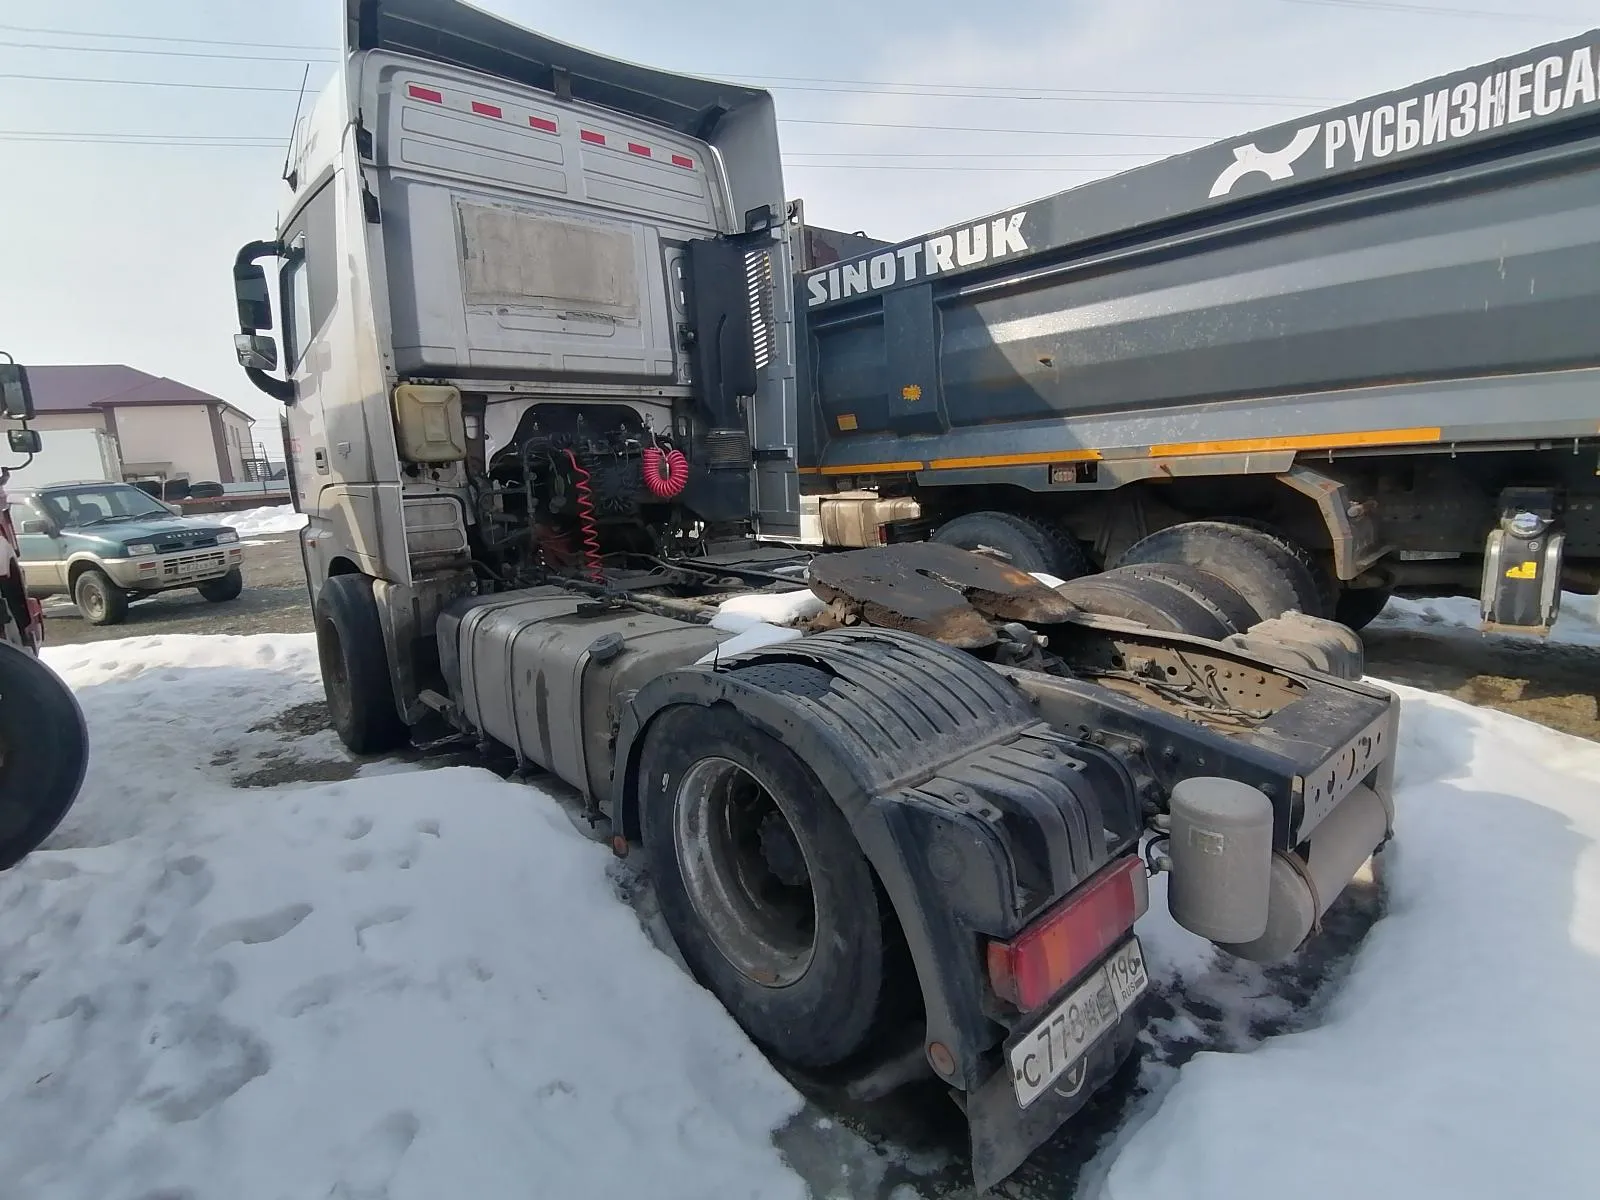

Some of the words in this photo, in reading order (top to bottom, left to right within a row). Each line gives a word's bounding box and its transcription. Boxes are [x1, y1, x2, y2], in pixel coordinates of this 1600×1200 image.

[1325, 46, 1600, 169] РУСБИЗНЕСА
[807, 211, 1028, 307] SINOTRUK
[1121, 981, 1136, 1001] RUS
